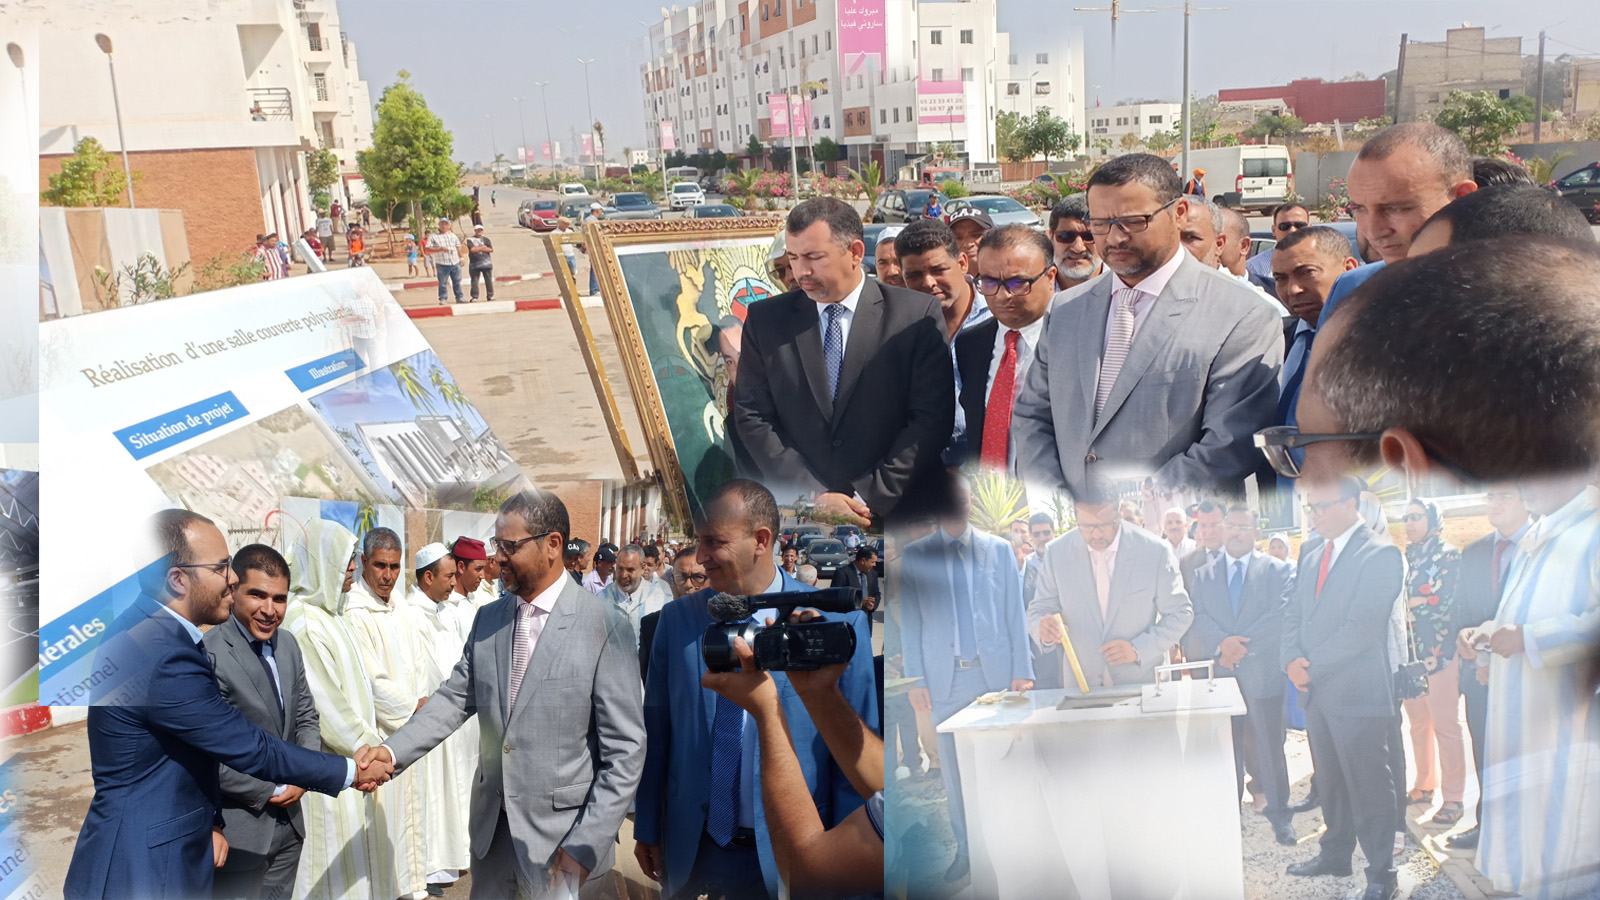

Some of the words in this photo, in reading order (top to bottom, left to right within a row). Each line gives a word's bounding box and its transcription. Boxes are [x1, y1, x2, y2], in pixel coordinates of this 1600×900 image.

[859, 7, 879, 17] مبروك
[950, 207, 982, 221] CAP
[80, 352, 183, 388] Réalisation
[184, 341, 228, 360] d'une
[226, 328, 258, 349] salle
[256, 315, 303, 341] couverte
[308, 360, 349, 380] Illustration
[129, 423, 188, 449] Situation
[186, 414, 203, 428] de
[201, 402, 234, 425] projet
